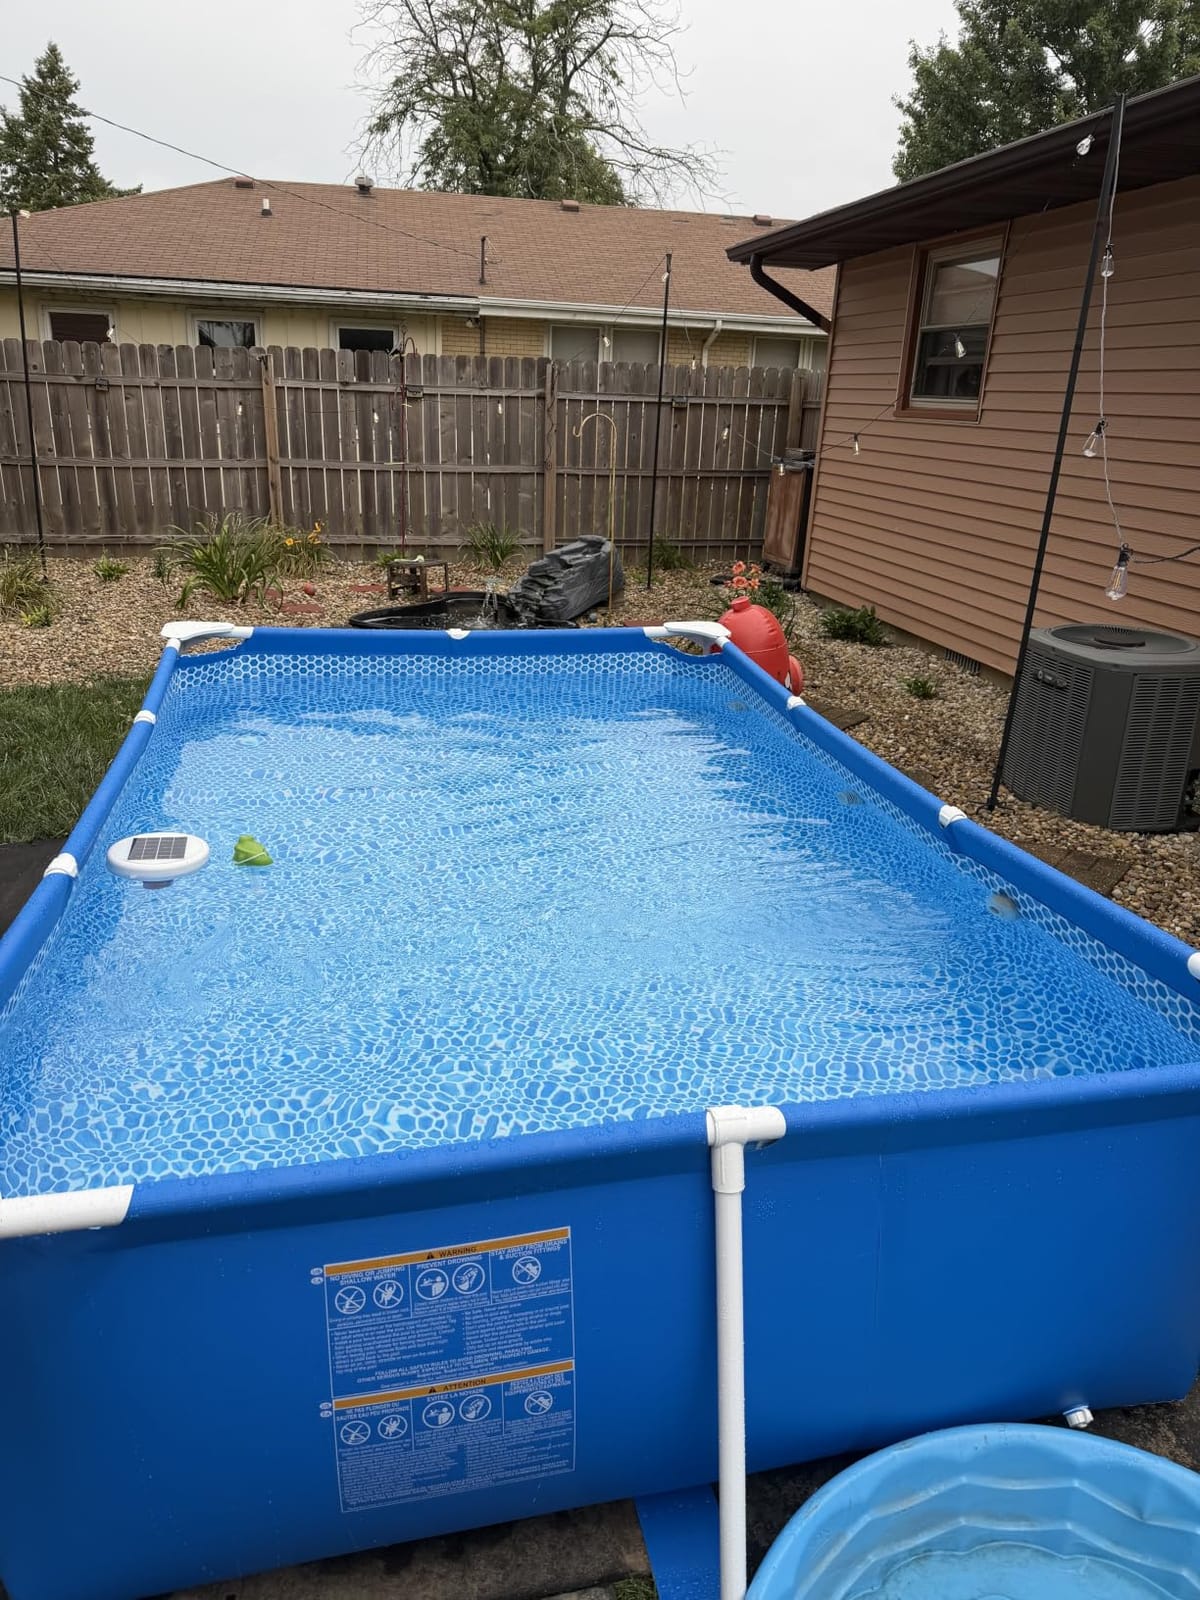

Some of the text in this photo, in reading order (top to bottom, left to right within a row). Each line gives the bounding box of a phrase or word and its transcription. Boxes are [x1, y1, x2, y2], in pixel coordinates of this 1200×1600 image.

[439, 1246, 477, 1258] WARNING
[416, 1261, 446, 1270] PREVENT
[340, 1273, 396, 1286] SHALLOW WATER
[341, 1271, 364, 1280] DIVING
[443, 1378, 486, 1391] ATTENTION
